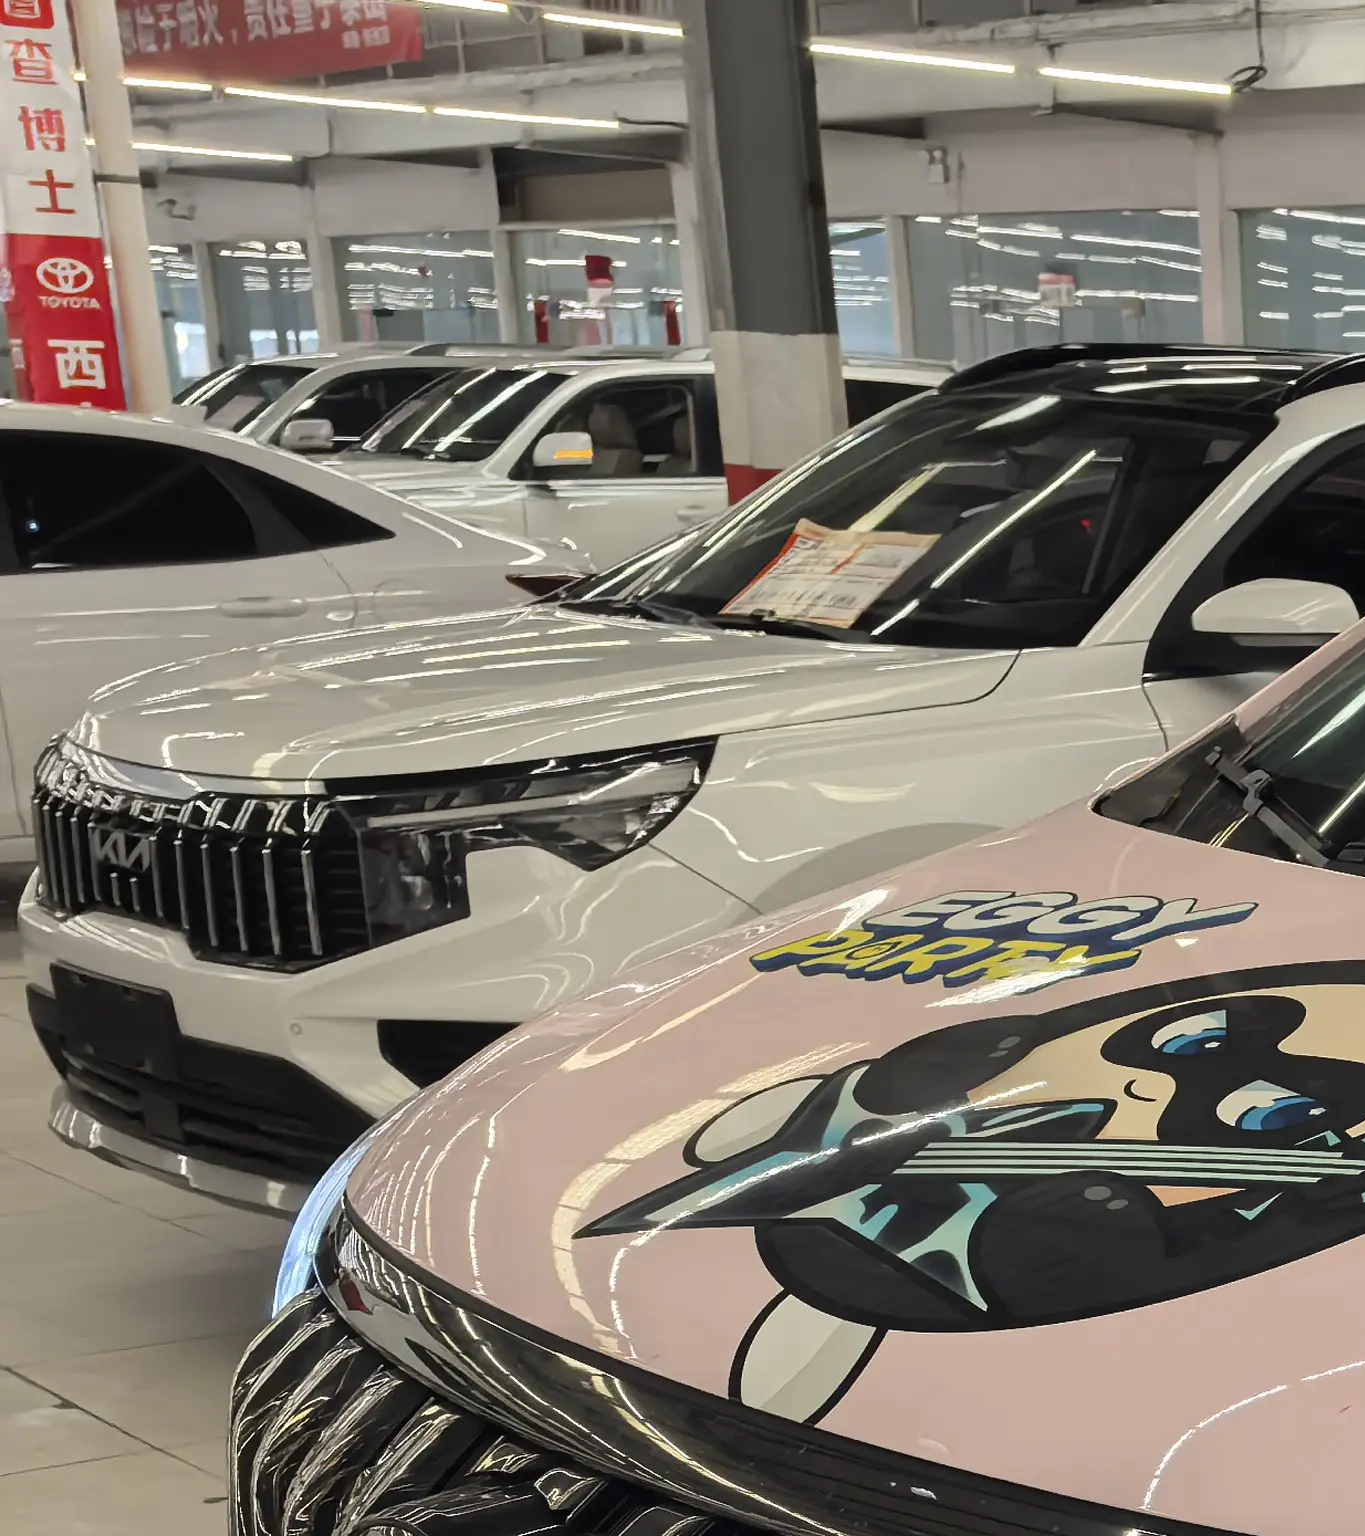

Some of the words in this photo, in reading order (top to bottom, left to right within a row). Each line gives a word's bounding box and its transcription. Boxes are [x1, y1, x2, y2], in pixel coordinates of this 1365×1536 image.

[5, 38, 77, 214] 查博士
[38, 295, 103, 310] TOYOTA
[861, 889, 1259, 946] EGGY
[749, 929, 1143, 995] PARTY
